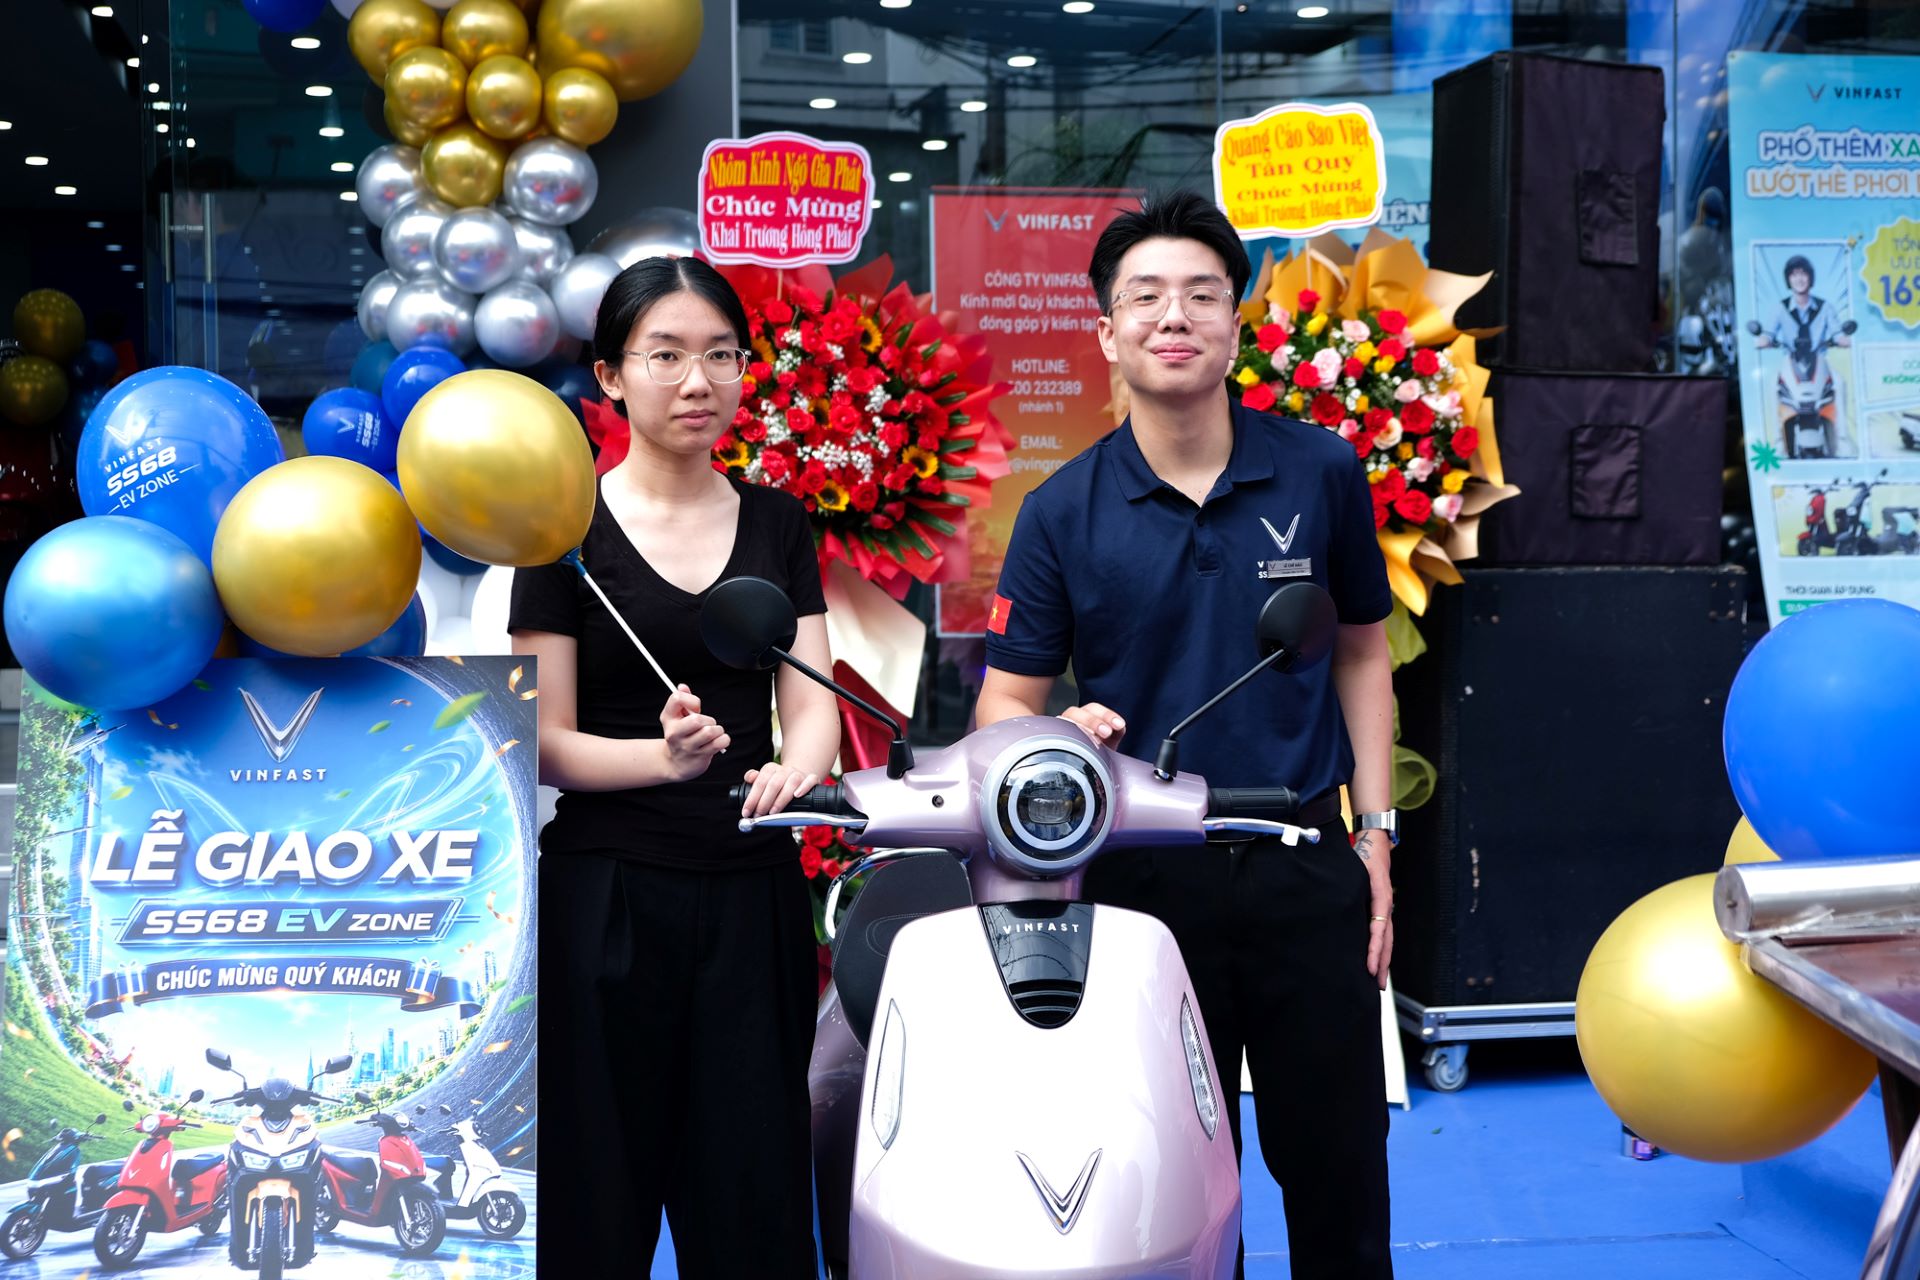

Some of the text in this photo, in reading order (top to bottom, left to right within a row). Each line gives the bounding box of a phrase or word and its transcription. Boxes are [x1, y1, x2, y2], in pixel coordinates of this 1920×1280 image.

[1834, 87, 1902, 99] VINFAST
[1275, 122, 1302, 150] Cáo
[1307, 120, 1333, 146] Sao
[1818, 132, 1882, 157] THÊM
[708, 152, 747, 191] Nhôm
[750, 149, 781, 186] Kính
[810, 153, 832, 188] Gia
[833, 156, 862, 193] Phát
[1246, 160, 1292, 178] Tân
[1751, 167, 1810, 193] LƯỚT
[1854, 172, 1908, 194] PHƠI
[1236, 187, 1291, 201] Chúc
[706, 194, 862, 222] Chúc Mừng
[1017, 214, 1094, 230] VINFAST
[710, 221, 740, 248] Khai
[744, 222, 788, 255] Trương
[825, 222, 853, 249] Phát
[984, 269, 1021, 287] CÔNG
[1024, 272, 1039, 287] TY
[1019, 292, 1044, 312] Quý
[1047, 293, 1084, 309] khách
[979, 315, 1012, 333] đóng
[1014, 315, 1039, 333] góp
[1041, 315, 1050, 333] ý
[1052, 315, 1078, 331] kiến
[1012, 358, 1070, 374] HOTLINE:
[1033, 381, 1082, 395] 232389
[1021, 436, 1063, 449] EMAIL:
[104, 437, 162, 472] VINFAST
[107, 446, 176, 496] SS68
[119, 469, 179, 508] EV ZONE
[230, 767, 327, 782] VINFAST
[90, 808, 480, 883] LỄ GIAO XE
[142, 907, 433, 935] SS68 EV ZONE
[1003, 922, 1079, 934] VINFAST
[156, 960, 401, 991] CHÚC MỪNG QUÝ KHÁCH
